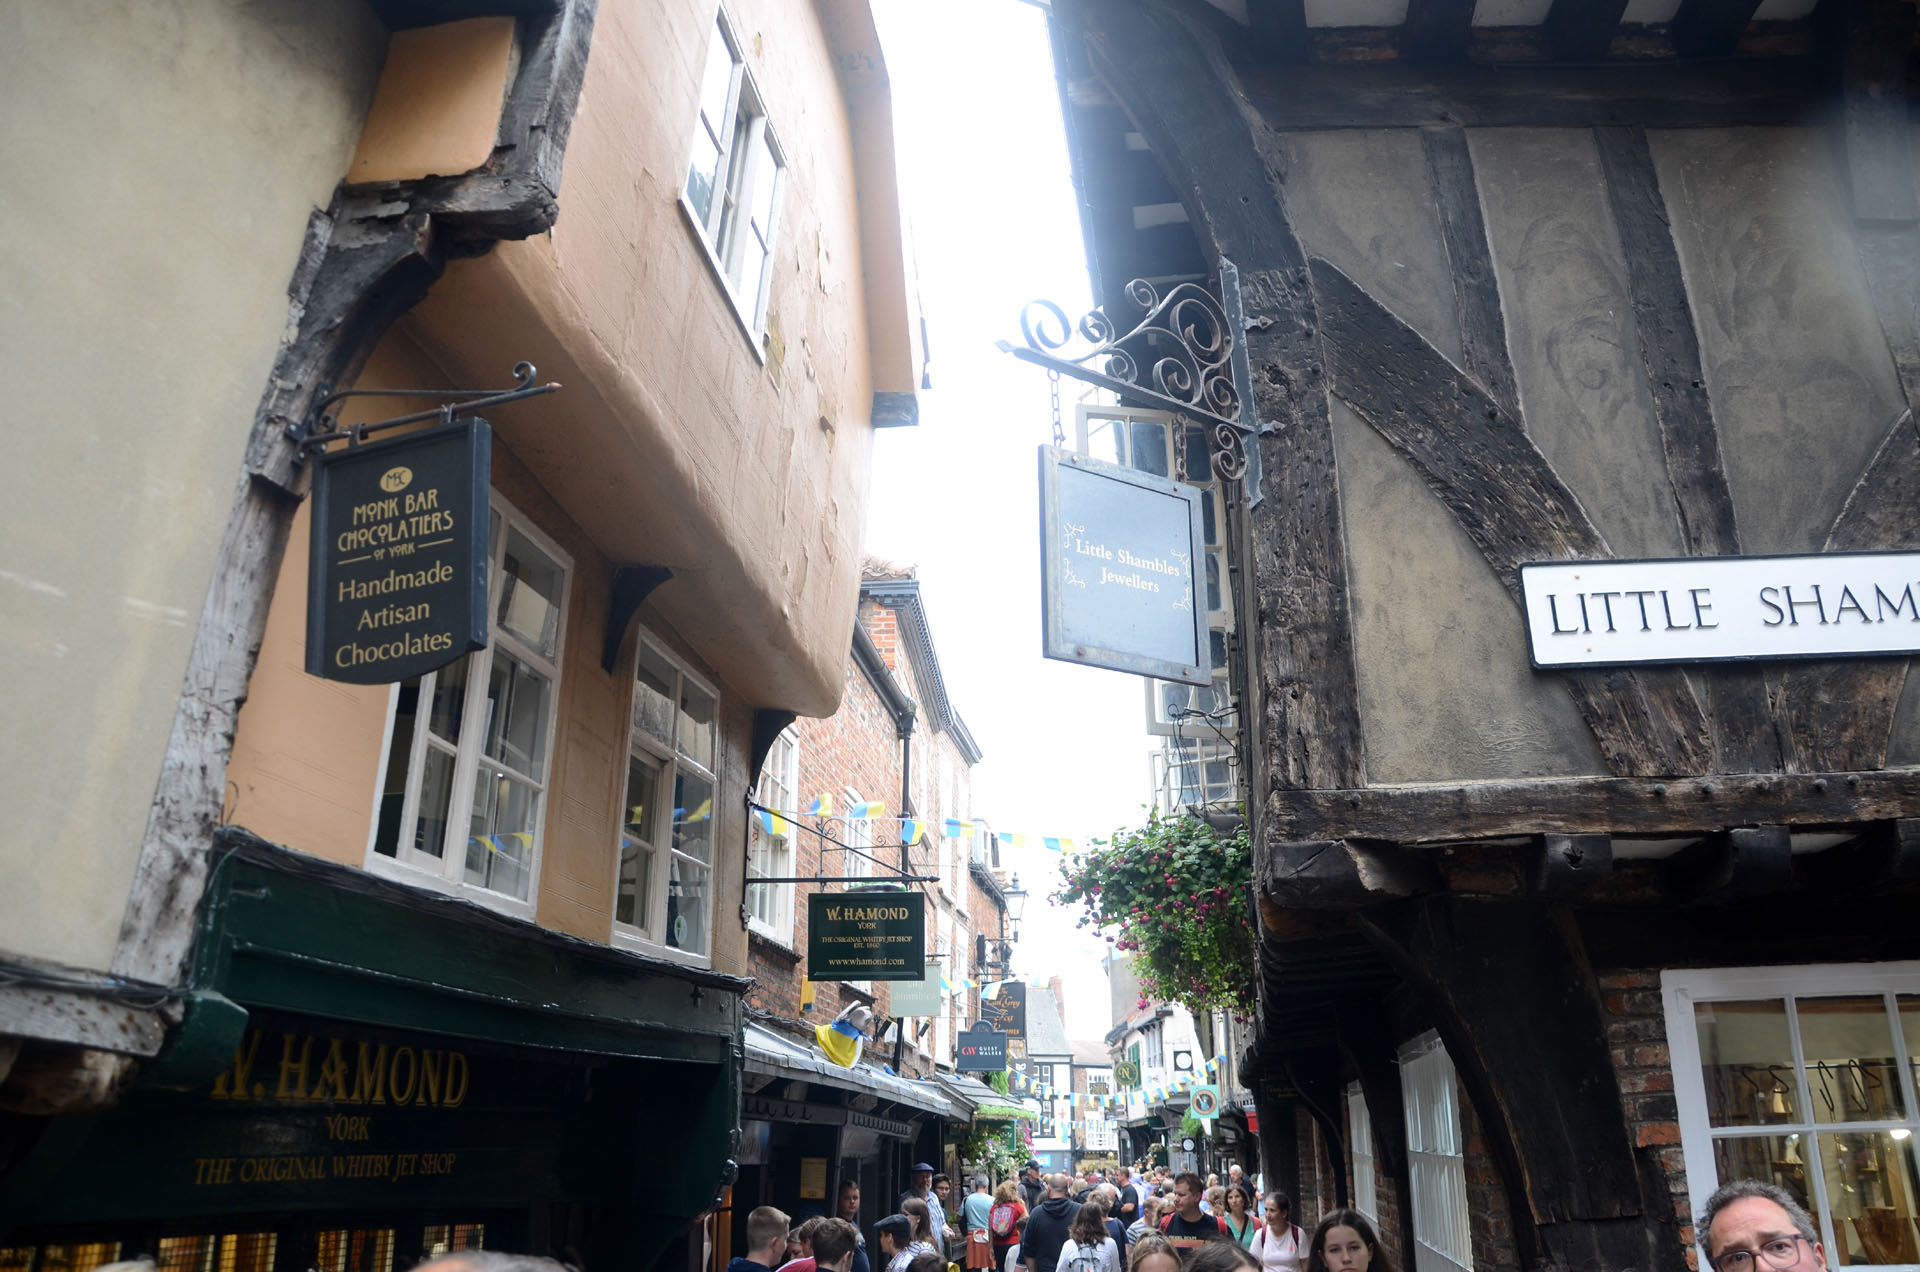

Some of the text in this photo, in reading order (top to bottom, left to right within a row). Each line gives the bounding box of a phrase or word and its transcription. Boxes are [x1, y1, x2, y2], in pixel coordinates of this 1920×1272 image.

[353, 488, 438, 526] MONK BAR
[337, 510, 454, 552] CHOCOLATIERS
[373, 542, 415, 560] OF YORK
[1075, 538, 1180, 577] Little Shambles
[338, 560, 453, 602] Handmade
[1099, 567, 1160, 593] Jewellers
[357, 602, 430, 632] Artisan
[1546, 579, 1920, 635] LITTLE SHAM
[335, 632, 453, 668] Chocolates
[826, 906, 909, 921] W. HAMOND
[857, 922, 877, 930] YORK
[275, 1033, 470, 1109] HAMOND
[325, 1113, 373, 1142] YORK
[194, 1152, 456, 1186] THE ORIGINAL WHITBY JET SHOP
